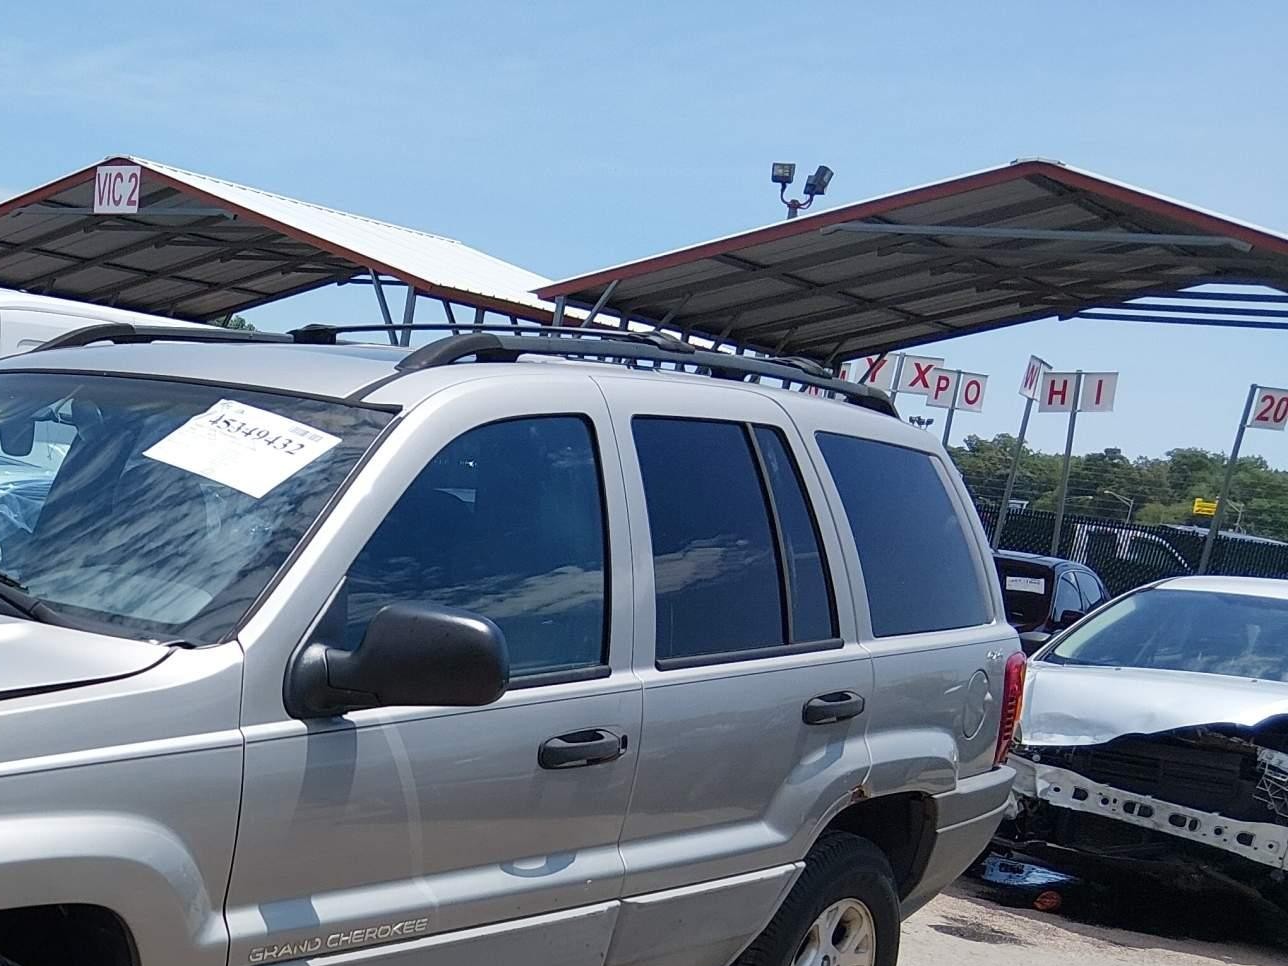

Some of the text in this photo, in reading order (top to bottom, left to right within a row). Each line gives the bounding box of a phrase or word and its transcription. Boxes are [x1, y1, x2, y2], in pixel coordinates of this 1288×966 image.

[97, 172, 139, 207] VIC 2
[866, 357, 888, 383] Y
[908, 362, 937, 389] X
[934, 375, 950, 400] P
[1048, 379, 1103, 406] H I
[1255, 394, 1288, 423] 20
[208, 413, 305, 456] 45349432
[248, 917, 429, 963] GRAND CHEROKEE
